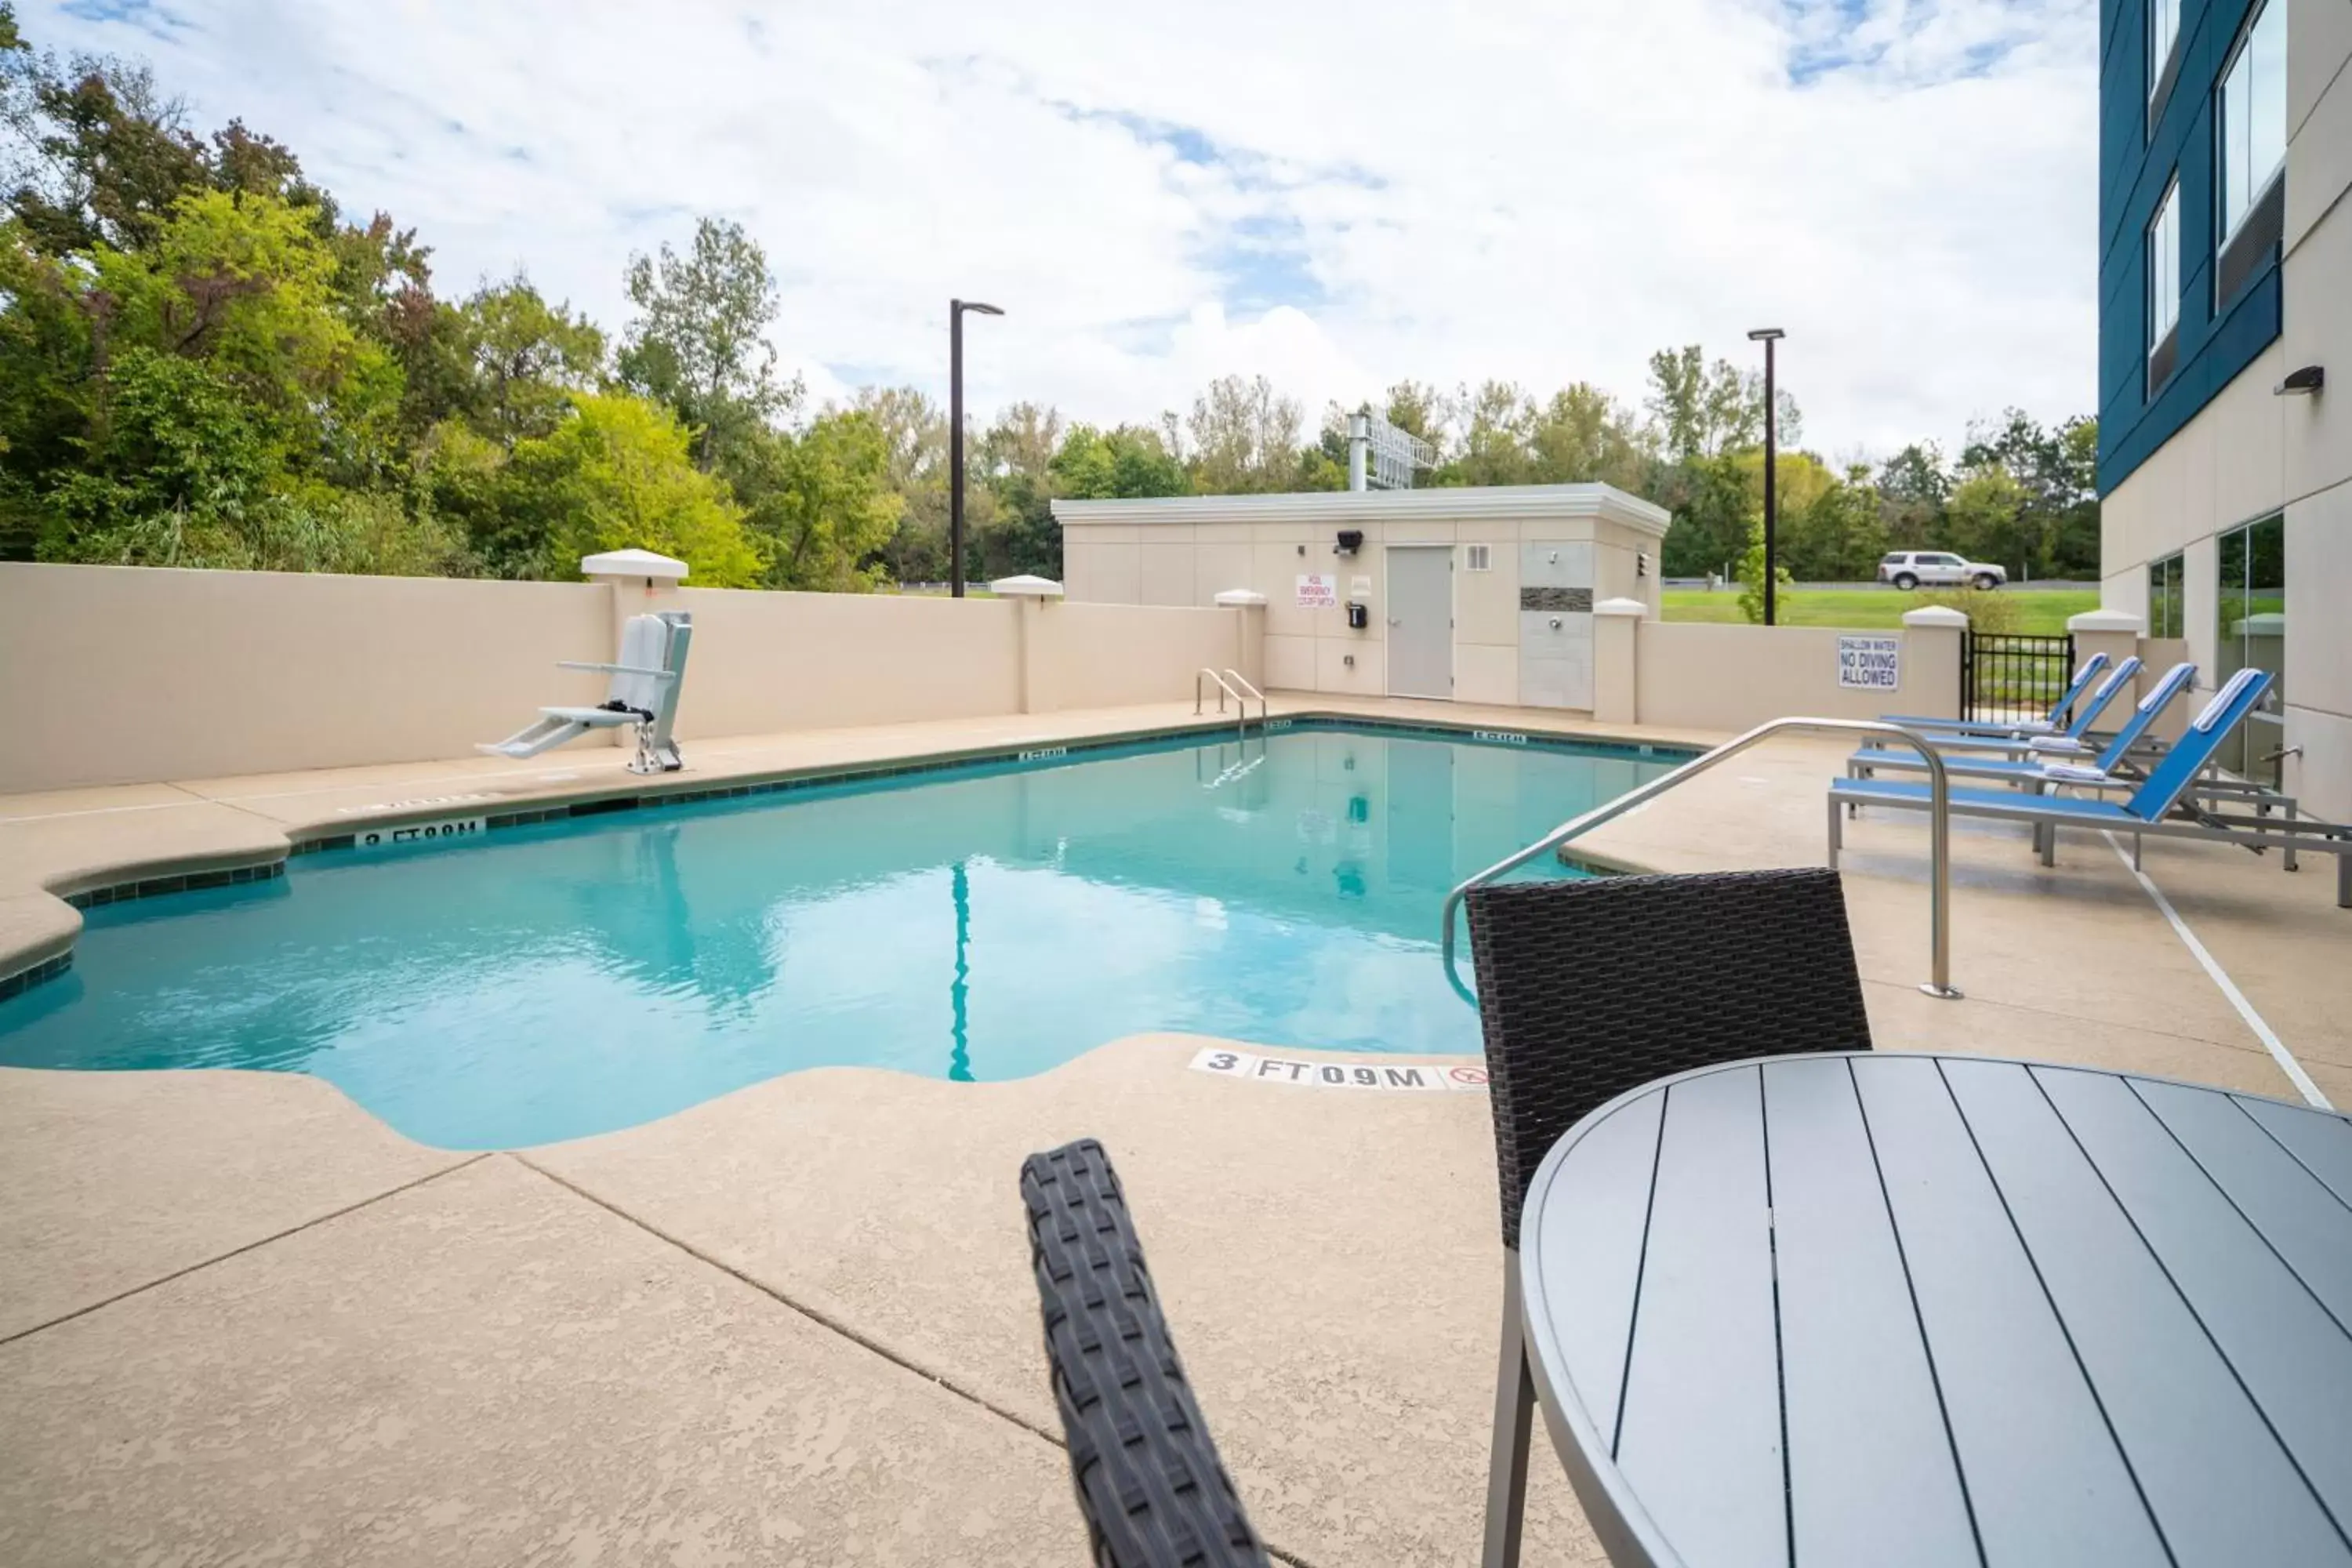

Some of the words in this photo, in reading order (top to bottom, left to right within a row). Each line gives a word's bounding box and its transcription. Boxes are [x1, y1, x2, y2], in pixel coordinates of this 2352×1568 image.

[1841, 652, 1856, 667] NO
[1859, 652, 1896, 669] DIVING
[1842, 669, 1895, 686] ALLOWED
[1208, 1054, 1240, 1070] 3
[1258, 1059, 1310, 1080] FT
